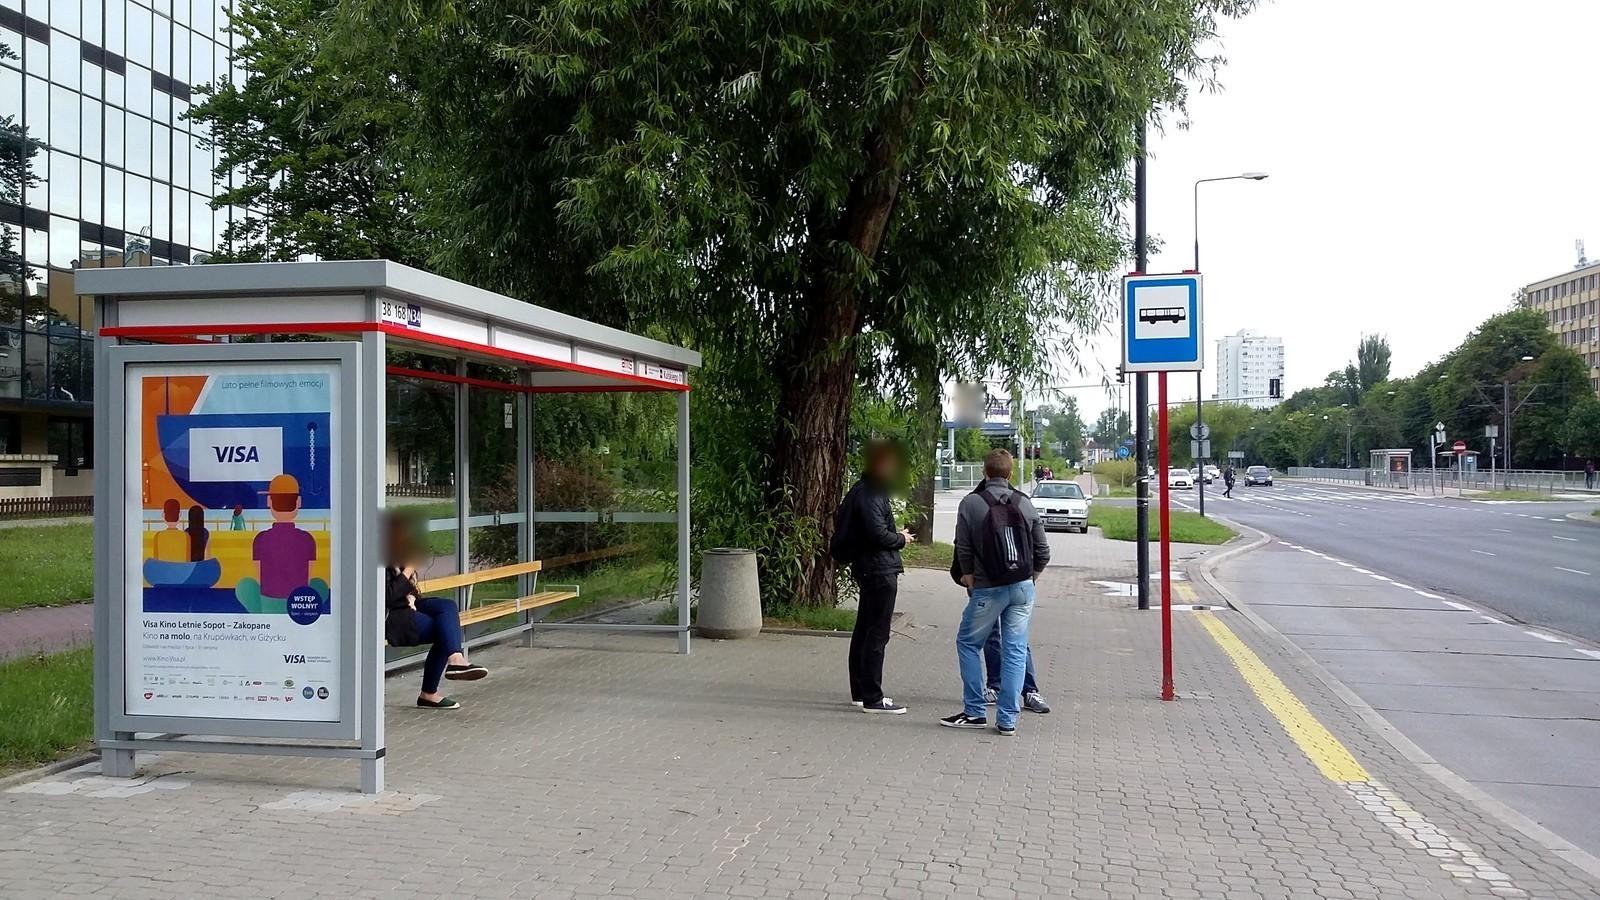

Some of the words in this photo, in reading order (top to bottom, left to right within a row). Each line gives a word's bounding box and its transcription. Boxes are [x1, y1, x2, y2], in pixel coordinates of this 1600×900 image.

[382, 302, 392, 316] 38
[394, 304, 407, 320] 168
[260, 379, 297, 390] filmowych
[299, 379, 324, 390] emocji
[212, 446, 259, 463] VISA
[142, 620, 158, 628] Visa
[159, 621, 177, 629] Kino
[178, 621, 202, 629] Letnie
[203, 621, 226, 631] Sopot
[233, 621, 271, 631] Zakopane
[142, 632, 159, 640] Kino
[258, 633, 287, 643] Giżycku
[283, 654, 306, 664] VISA
